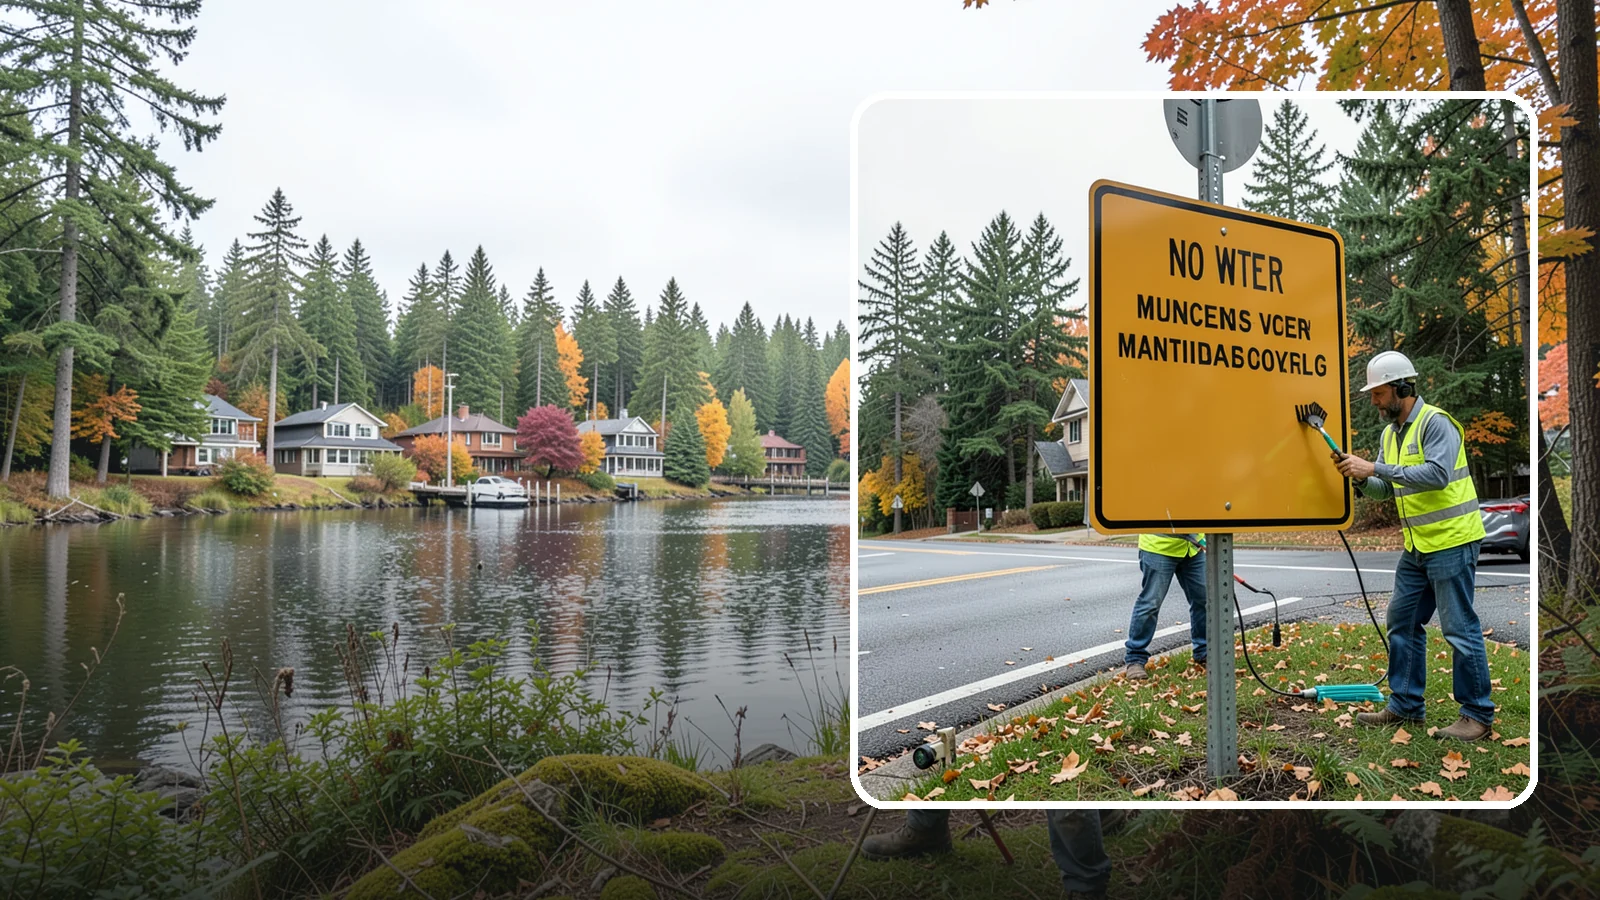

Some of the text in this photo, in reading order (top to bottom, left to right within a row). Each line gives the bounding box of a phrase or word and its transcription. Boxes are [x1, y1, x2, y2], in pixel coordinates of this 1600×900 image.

[1170, 238, 1284, 295] NO WTER
[1137, 294, 1252, 333] MUNCENS
